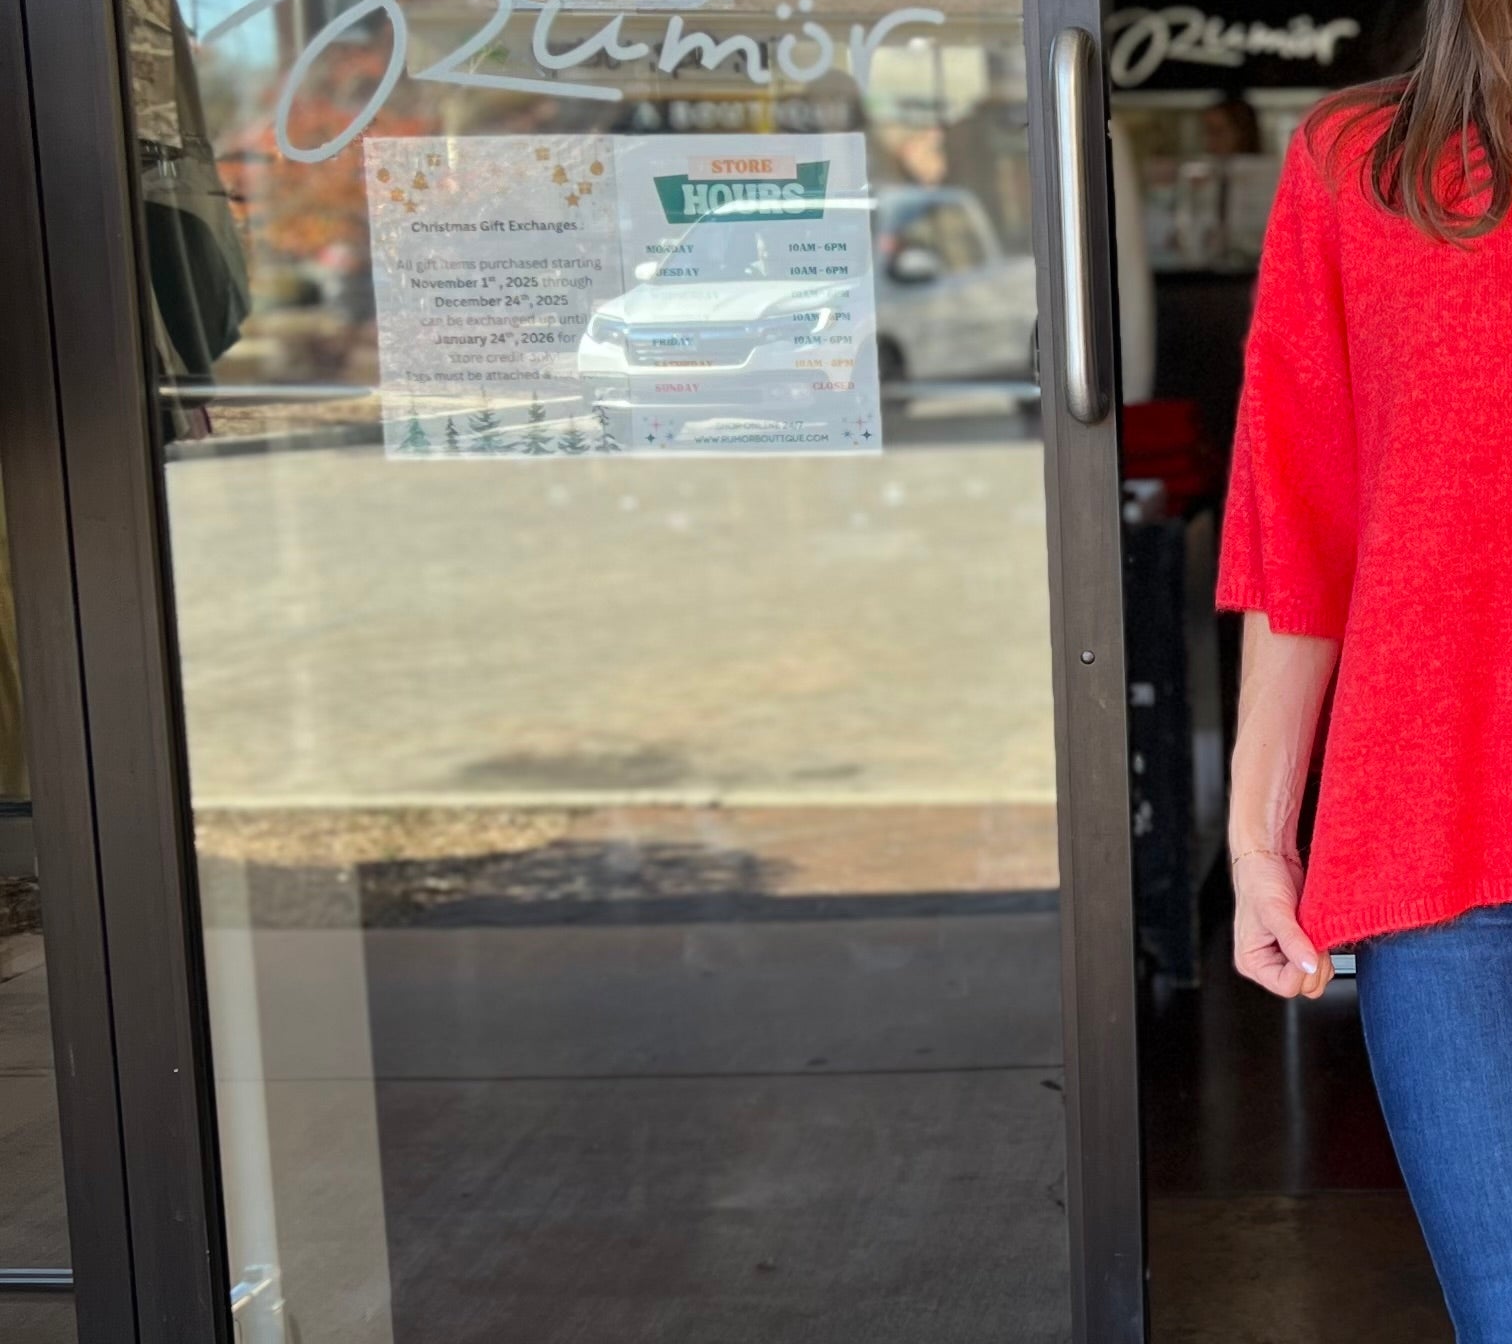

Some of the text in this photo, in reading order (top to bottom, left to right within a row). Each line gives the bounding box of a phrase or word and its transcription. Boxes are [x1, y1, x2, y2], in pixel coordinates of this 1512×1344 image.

[712, 159, 773, 174] STORE
[682, 183, 805, 215] HOURS
[411, 221, 477, 234] Christmas
[480, 221, 505, 234] Gift
[509, 221, 578, 234] Exchanges
[789, 243, 816, 252] 10AM
[824, 243, 847, 252] 6PM
[396, 258, 413, 272] All
[415, 258, 438, 272] gift
[479, 258, 548, 272] purchased
[551, 258, 603, 272] starting
[790, 266, 817, 275] 10AM
[826, 266, 848, 275] 6PM
[410, 277, 477, 289] November
[506, 277, 539, 288] 2025
[542, 276, 593, 290] through
[435, 295, 501, 307] December
[536, 295, 568, 307] 2025
[446, 315, 464, 327] be
[466, 315, 535, 327] exchanged
[559, 315, 588, 327] until
[435, 333, 487, 346] January
[521, 333, 555, 346] 2026
[557, 333, 577, 346] for
[652, 337, 692, 347] FRIDAY
[794, 336, 821, 345] 10AM
[830, 336, 852, 345] 6PM
[450, 353, 483, 364] store
[486, 353, 524, 364] credit
[435, 371, 464, 381] must
[467, 371, 483, 381] be
[486, 371, 539, 381] attached
[656, 384, 700, 393] SUNDAY
[813, 381, 855, 391] CLOSED
